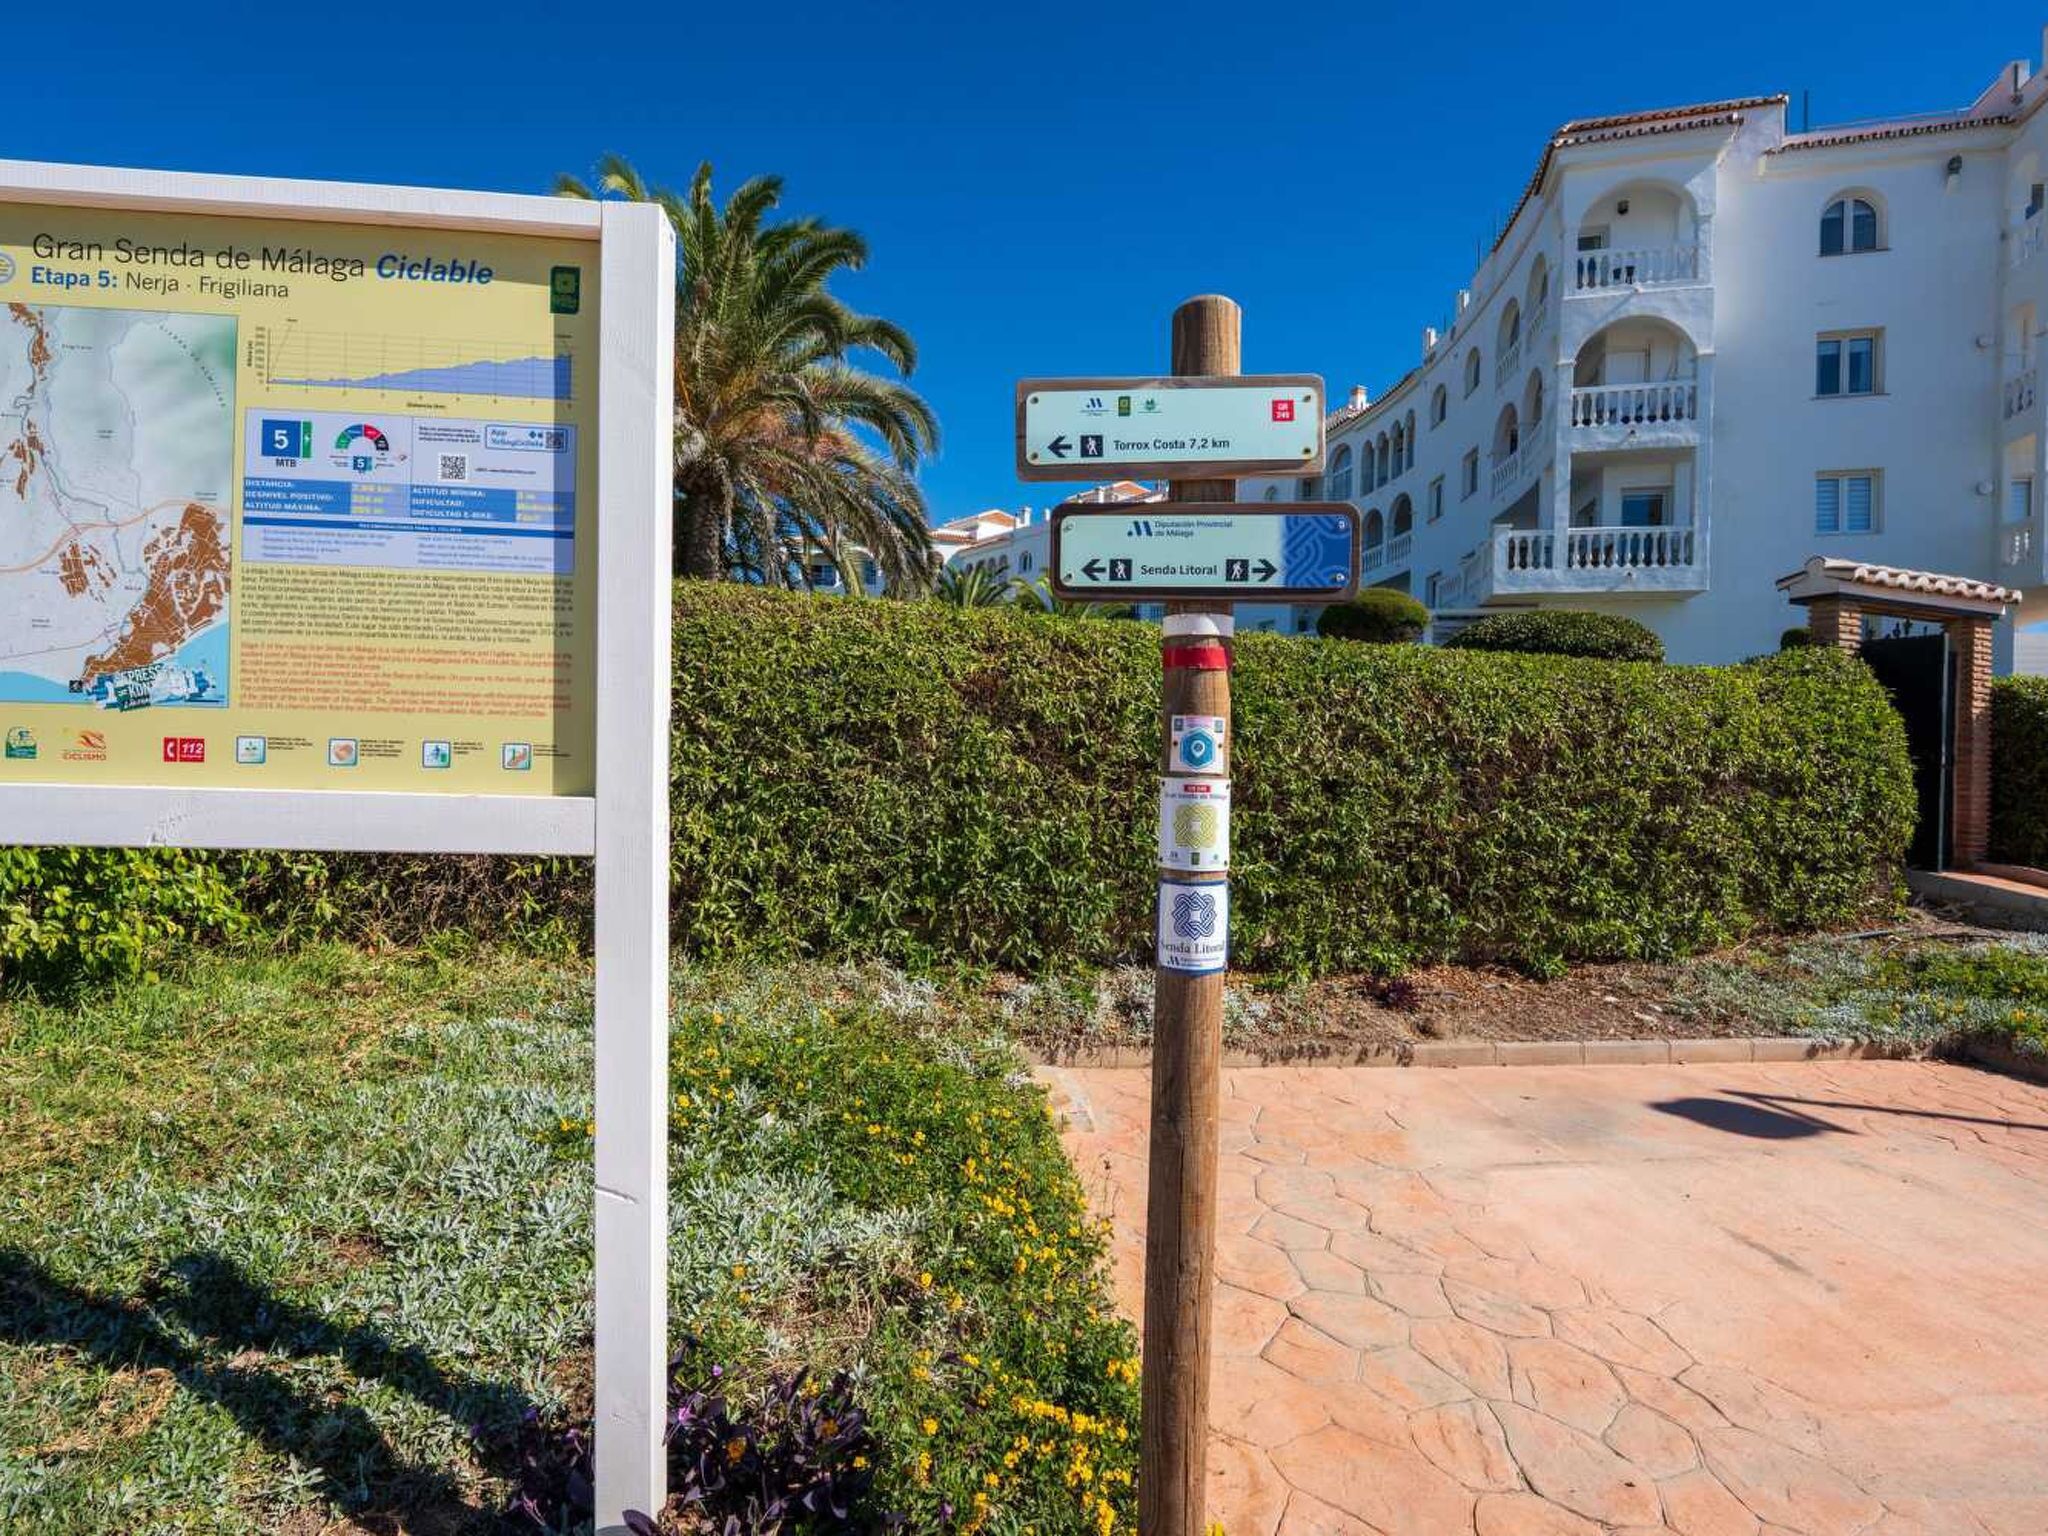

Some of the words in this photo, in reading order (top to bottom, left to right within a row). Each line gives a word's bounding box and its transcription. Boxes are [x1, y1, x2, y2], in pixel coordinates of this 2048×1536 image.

[33, 233, 103, 262] Gran
[115, 238, 205, 267] Senda
[216, 245, 251, 270] de
[262, 246, 365, 282] Málaga
[377, 254, 493, 285] Ciclable
[31, 267, 90, 289] Etapa
[98, 270, 118, 289] 5:
[126, 271, 180, 296] Nerja
[200, 275, 289, 300] Frigiliana
[273, 429, 289, 449] 5
[1113, 439, 1150, 451] Torrox
[1153, 438, 1185, 450] Costa
[1189, 438, 1209, 451] 7,2
[1211, 438, 1230, 449] km
[276, 458, 297, 468] MTB
[356, 458, 365, 468] 5
[1140, 564, 1177, 576] Senda
[1179, 564, 1217, 576] Litoral
[181, 742, 204, 754] 112
